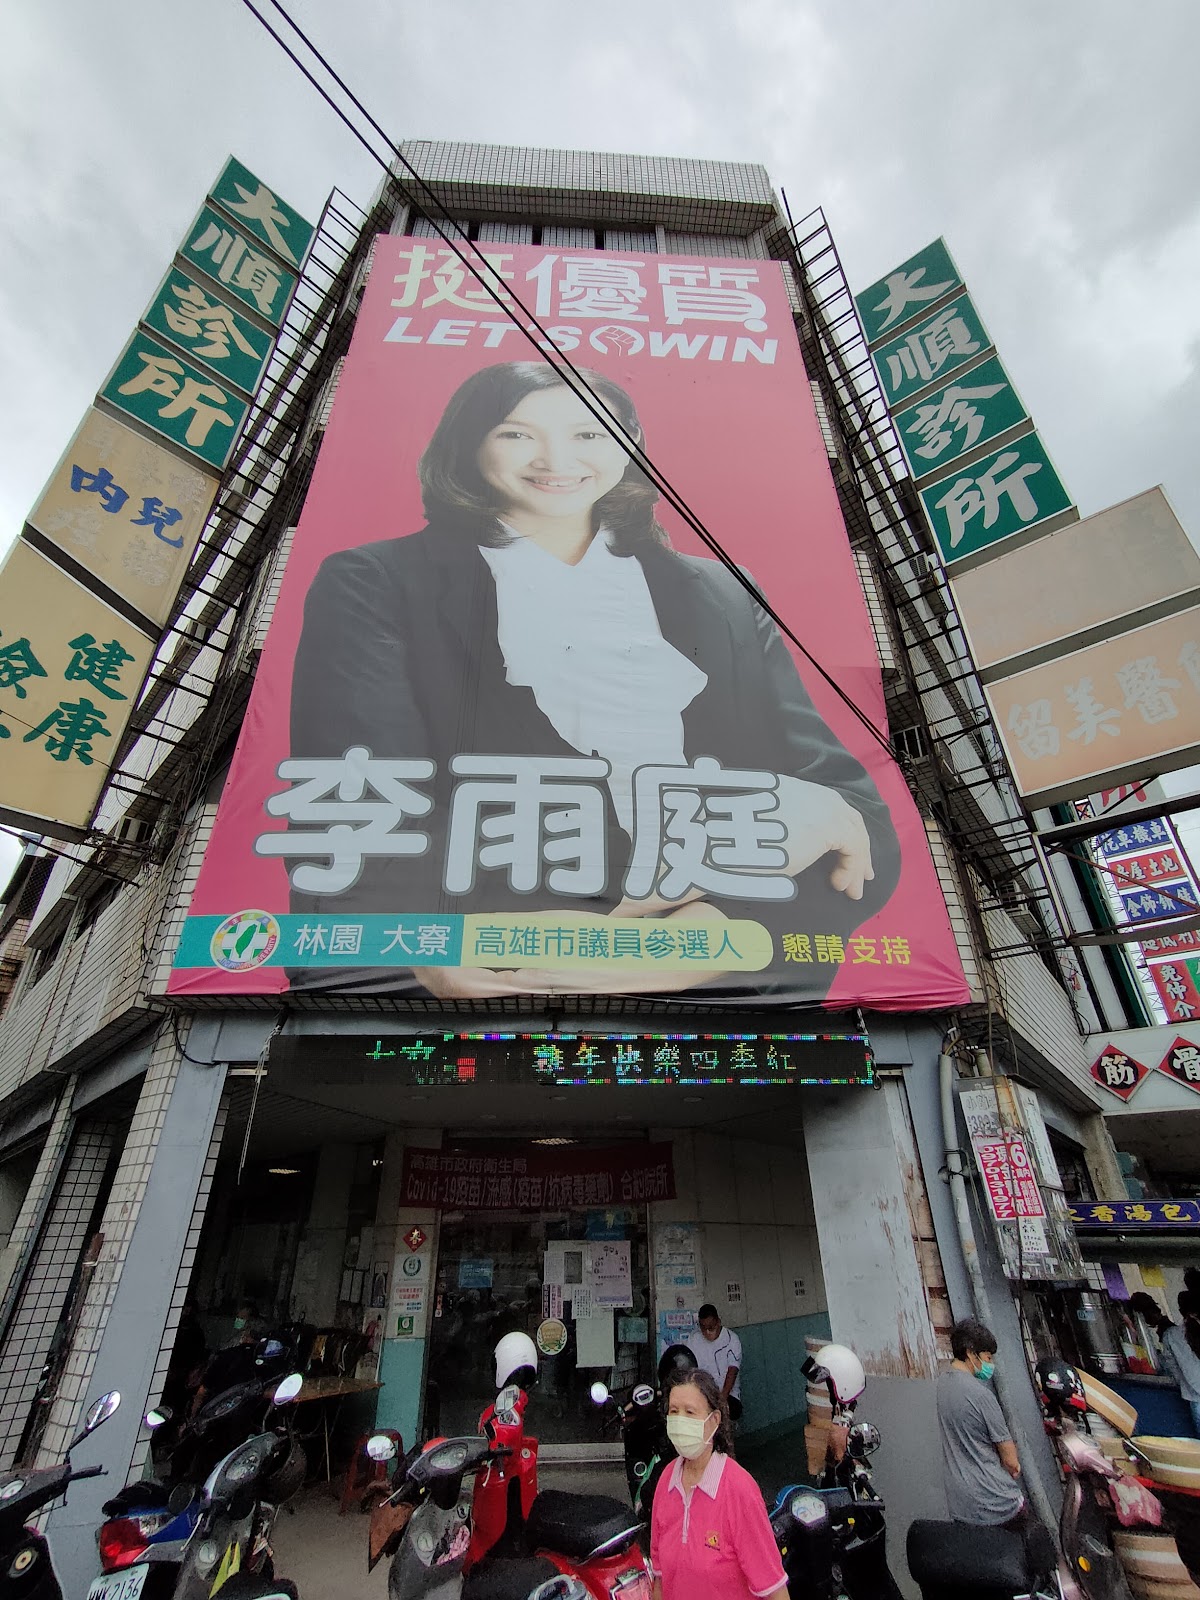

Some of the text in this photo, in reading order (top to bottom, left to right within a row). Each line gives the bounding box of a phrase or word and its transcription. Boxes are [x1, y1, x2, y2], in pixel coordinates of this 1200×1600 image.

[118, 182, 299, 447] 大順診所
[382, 316, 779, 365] LET'S WIN
[390, 244, 768, 332] 挺優質
[873, 266, 1043, 548] 大順診所
[23, 632, 136, 766] 健康
[254, 745, 798, 901] 李雨庭
[293, 923, 364, 956] 林園
[380, 923, 451, 956] 大寮
[474, 925, 744, 960] 高雄市議員參選人
[782, 933, 912, 965] 懇請支持
[1160, 964, 1196, 1018] 免仲介
